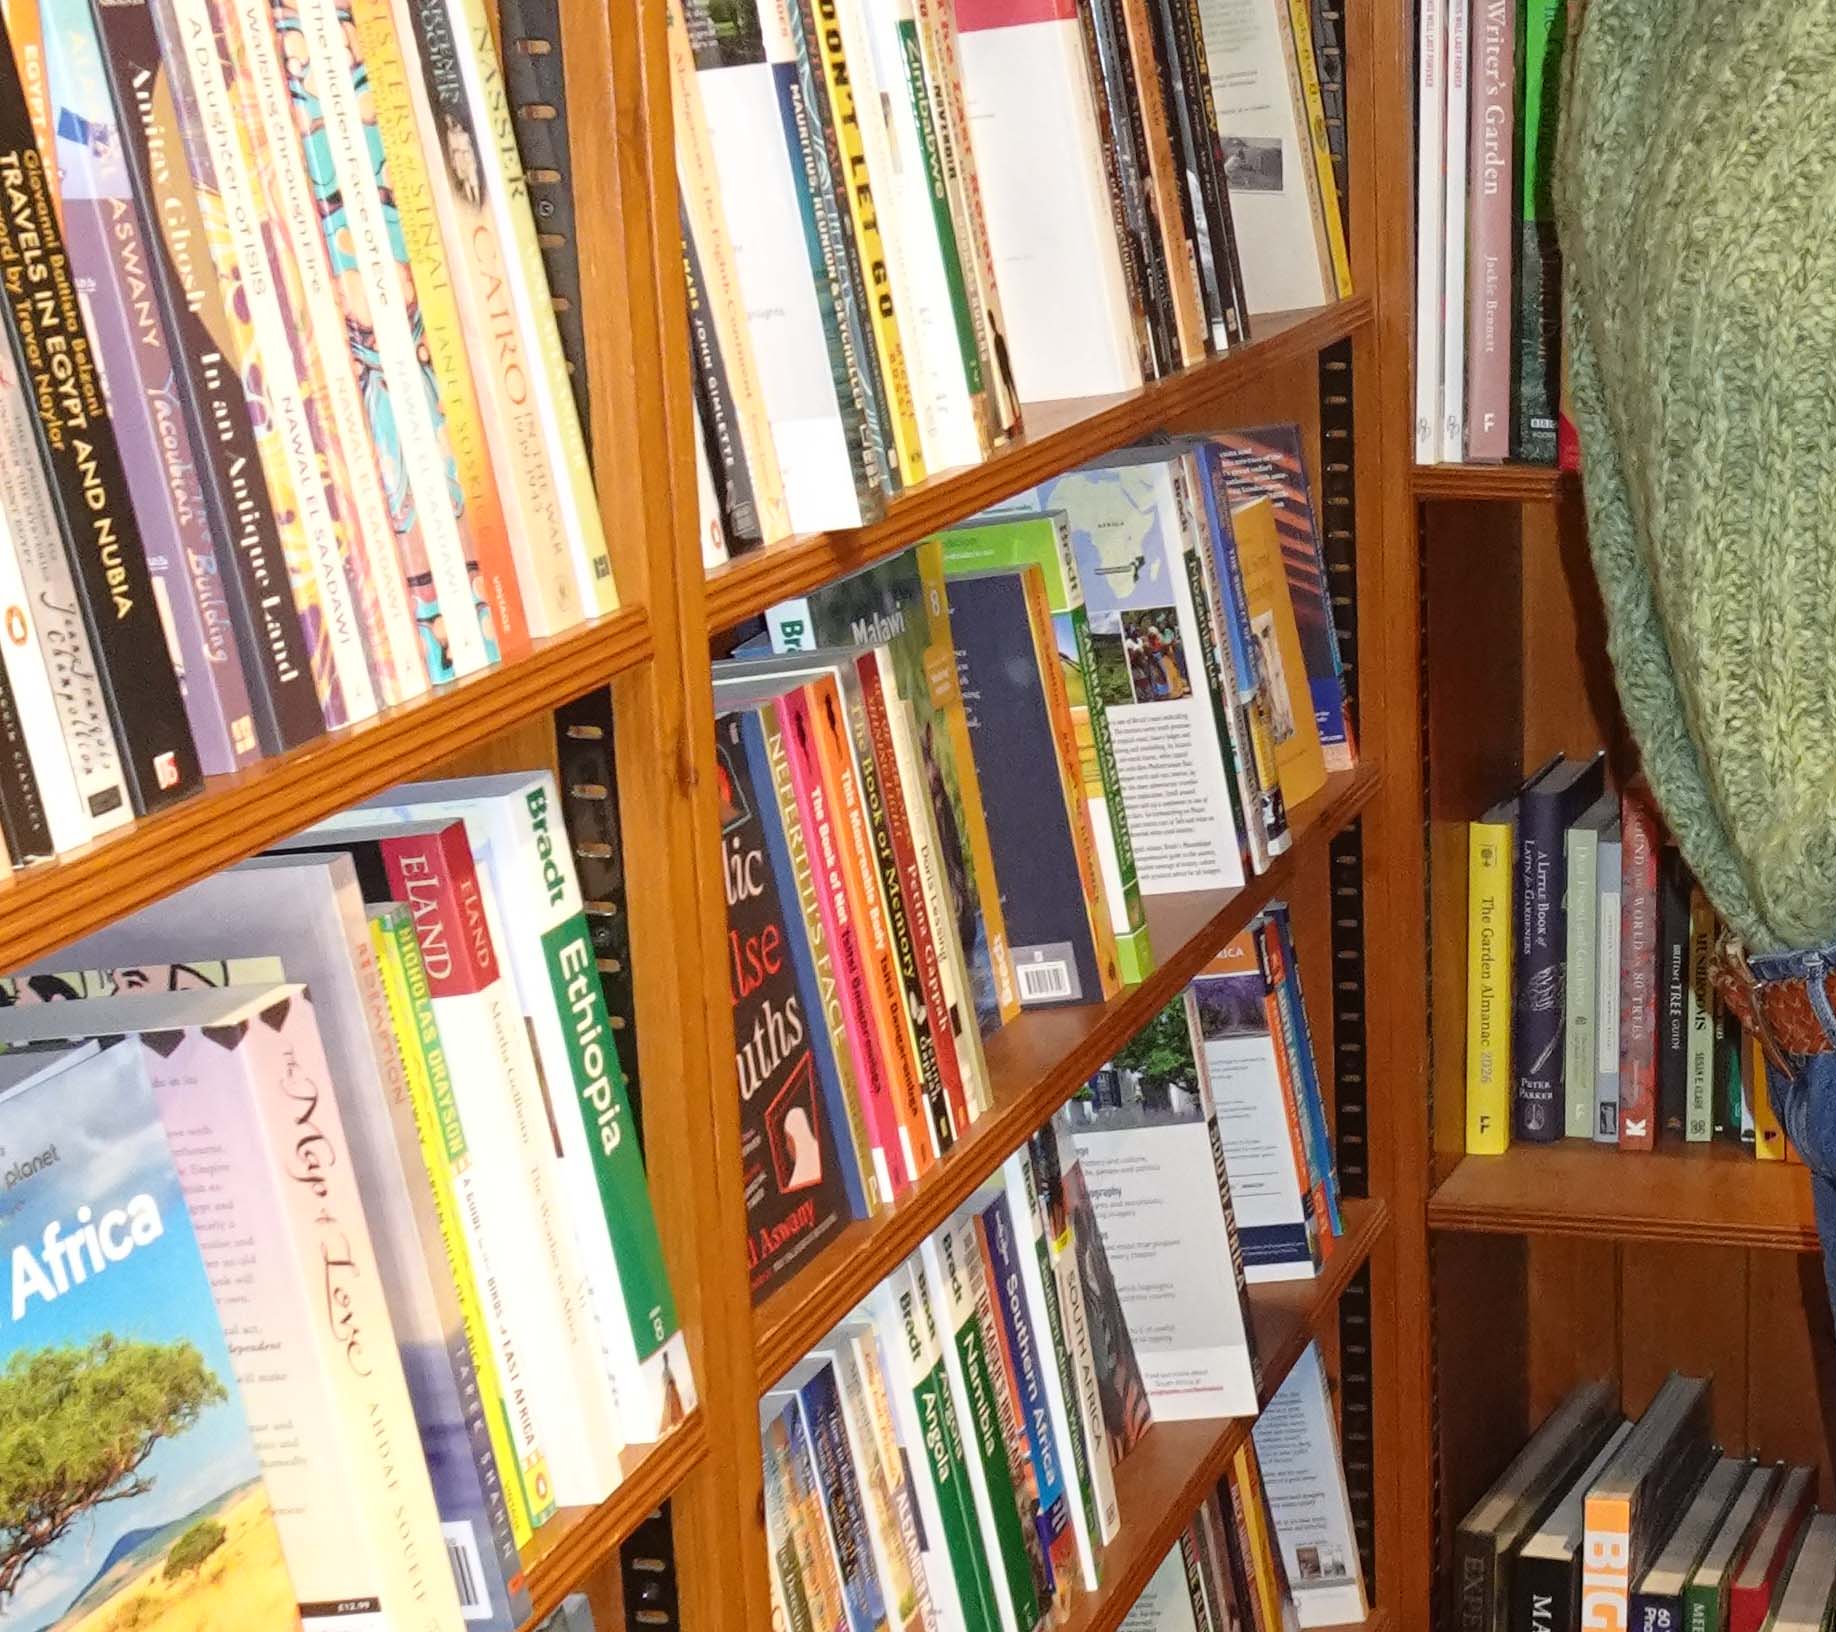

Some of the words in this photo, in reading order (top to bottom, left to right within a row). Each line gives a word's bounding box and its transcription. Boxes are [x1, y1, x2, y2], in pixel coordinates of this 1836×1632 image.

[1484, 0, 1508, 95] Writer's
[473, 25, 525, 201] NASSER
[905, 36, 945, 201] Zimbabwe
[1483, 104, 1504, 194] Garden
[2, 152, 48, 280] TRAVELS
[131, 62, 170, 184] Amitav
[163, 195, 202, 313] Ghosh
[852, 152, 880, 237] LET
[873, 261, 896, 319] GO
[34, 290, 59, 320] IN
[474, 224, 525, 406] CAIRO
[46, 335, 87, 427] EGYPT
[73, 441, 106, 509] AND
[202, 352, 222, 389] In
[212, 400, 232, 439] an
[227, 452, 270, 586] Antique
[260, 590, 297, 684] Land
[94, 517, 133, 620] NUBIA
[851, 603, 907, 644] Malawi
[401, 854, 451, 981] ELAND
[526, 787, 566, 907] Bradt
[560, 939, 622, 1157] Ethiopia
[11, 1188, 163, 1320] Africa
[963, 1334, 994, 1457] Namibia
[1006, 1276, 1037, 1402] Southern
[1033, 1408, 1054, 1486] Africa
[1581, 1529, 1628, 1628] BIG
